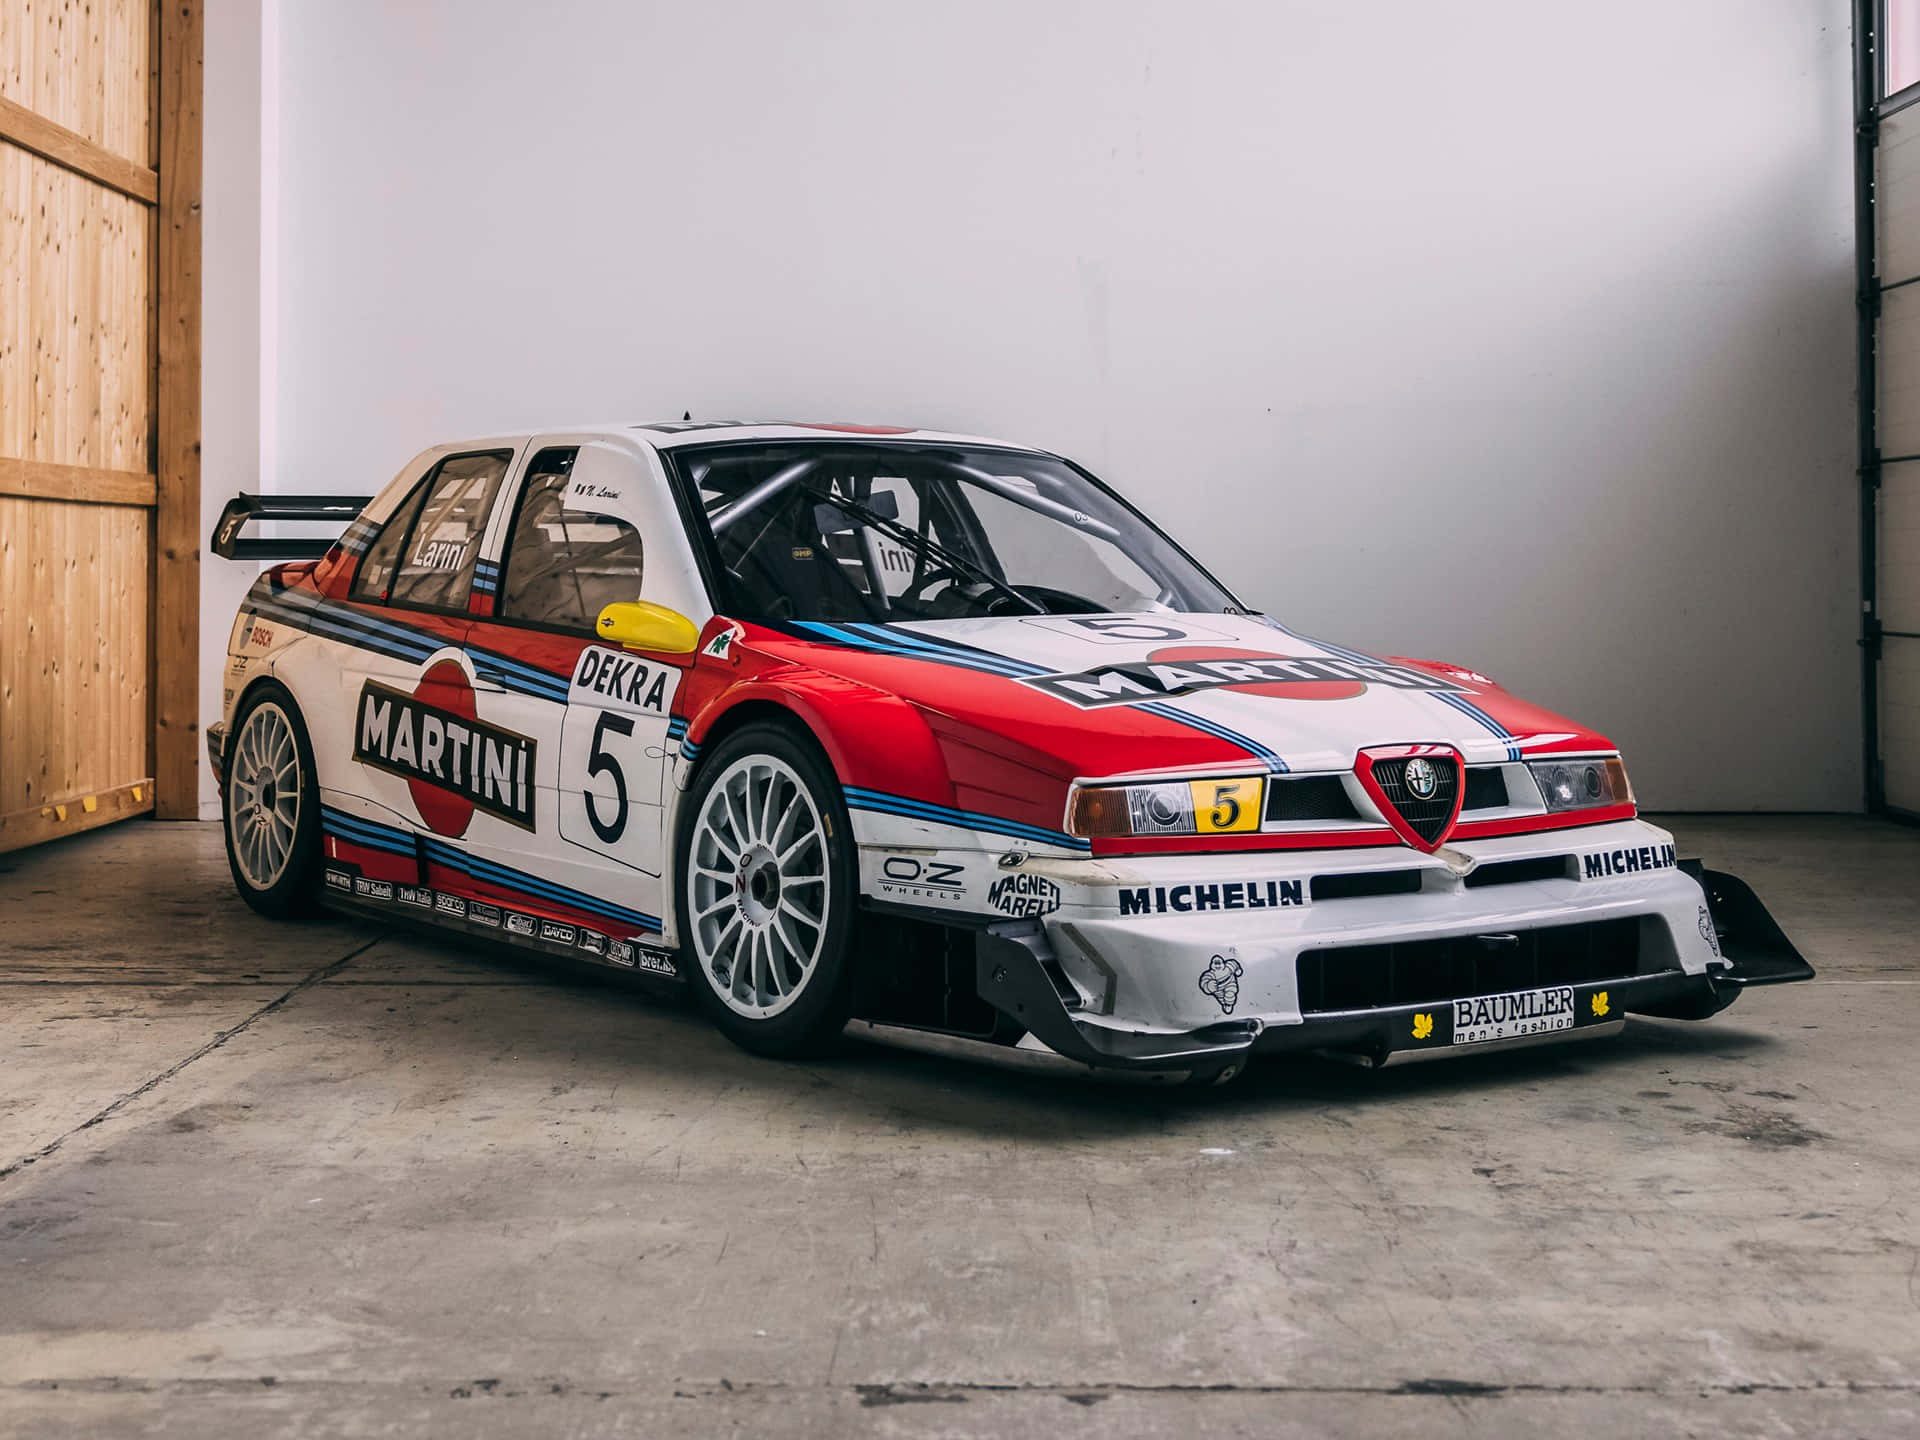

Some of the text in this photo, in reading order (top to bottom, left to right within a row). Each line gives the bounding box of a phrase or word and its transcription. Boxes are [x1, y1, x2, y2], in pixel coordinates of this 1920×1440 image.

[221, 519, 238, 544] 5
[412, 533, 470, 570] Larini
[1072, 618, 1187, 640] 5
[577, 650, 667, 712] DEKRA
[583, 710, 635, 844] 5
[1210, 784, 1241, 829] 5
[1584, 844, 1676, 878] MICHELIN
[357, 880, 370, 894] TRW
[883, 884, 961, 900] WHEELS
[988, 873, 1060, 904] MAGNETI
[1119, 880, 1304, 915] MICHELIN
[990, 893, 1060, 917] MARELLI
[543, 924, 574, 941] DAYCO
[1455, 987, 1574, 1028] BÄUMLER
[1455, 1017, 1573, 1043] men's fashion
